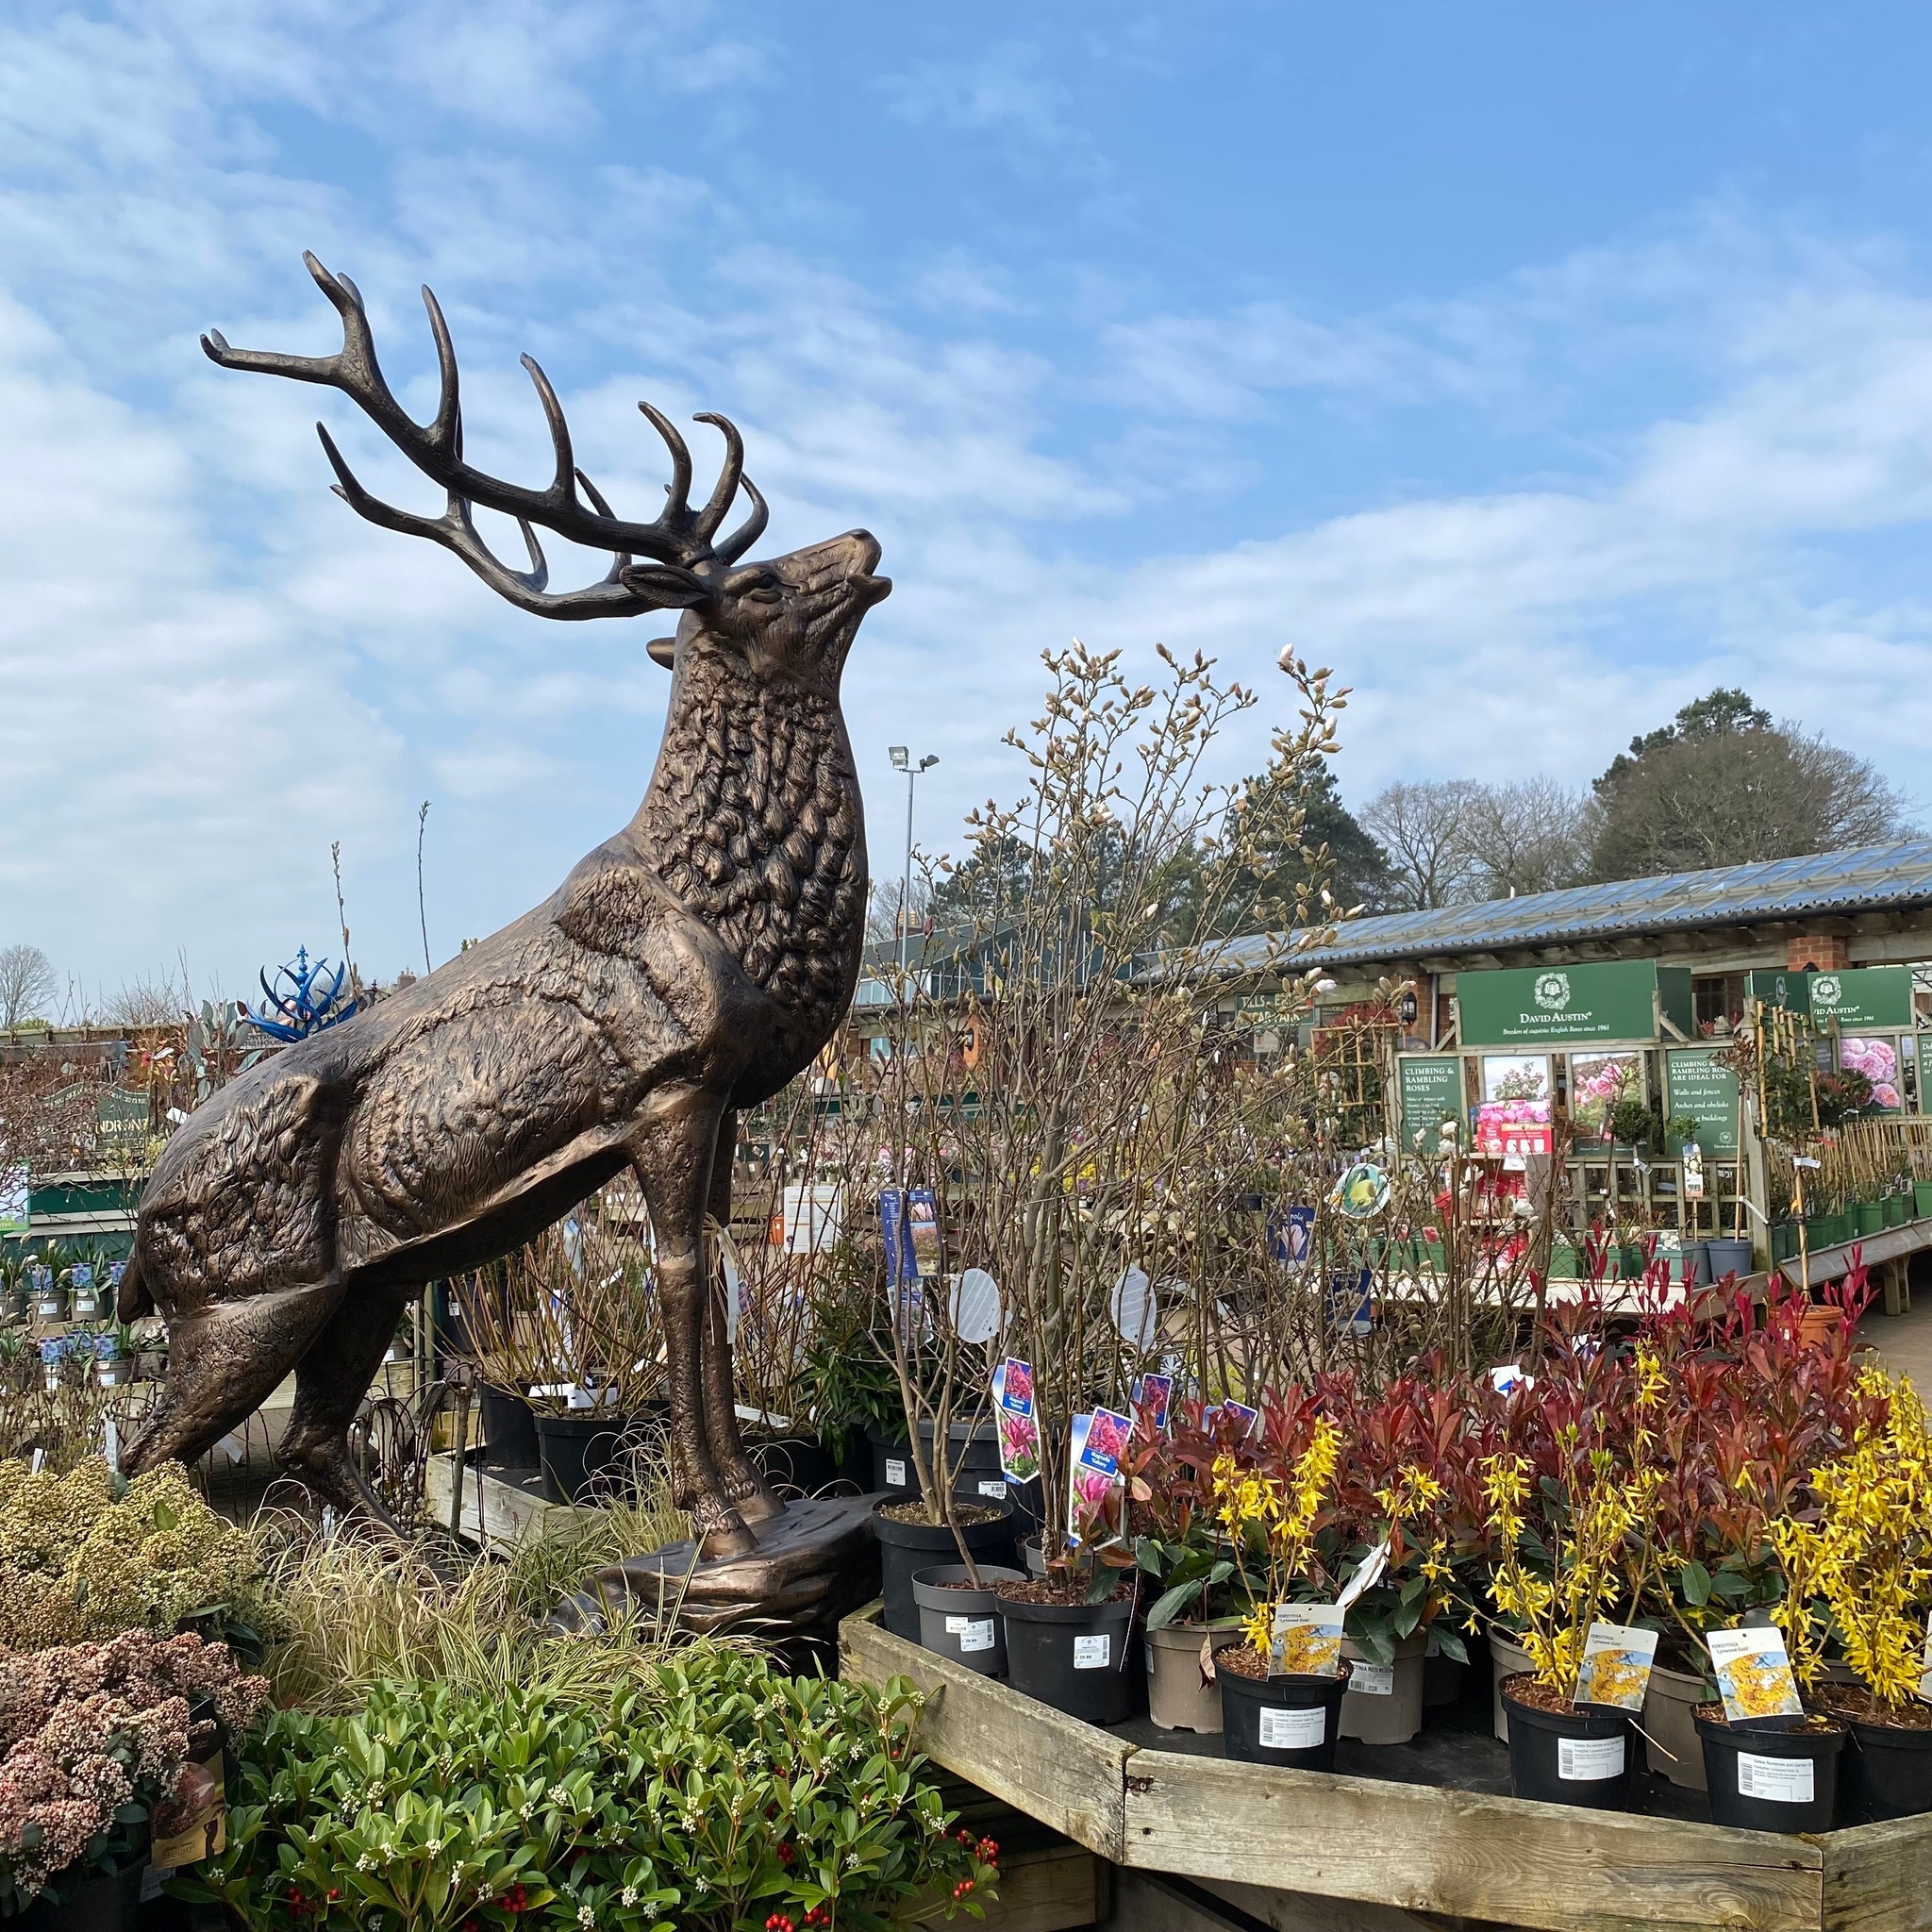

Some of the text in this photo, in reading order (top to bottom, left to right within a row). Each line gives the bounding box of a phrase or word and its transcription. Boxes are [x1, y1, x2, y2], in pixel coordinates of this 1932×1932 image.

[1520, 1013, 1551, 1024] DAVID
[1405, 1067, 1445, 1075] CLIMBING
[1406, 1075, 1448, 1084] RAMBLING
[1673, 1088, 1690, 1096] Walls
[1703, 1088, 1721, 1096] fences
[1674, 1101, 1693, 1109] Arches
[1707, 1100, 1729, 1108] obelisks
